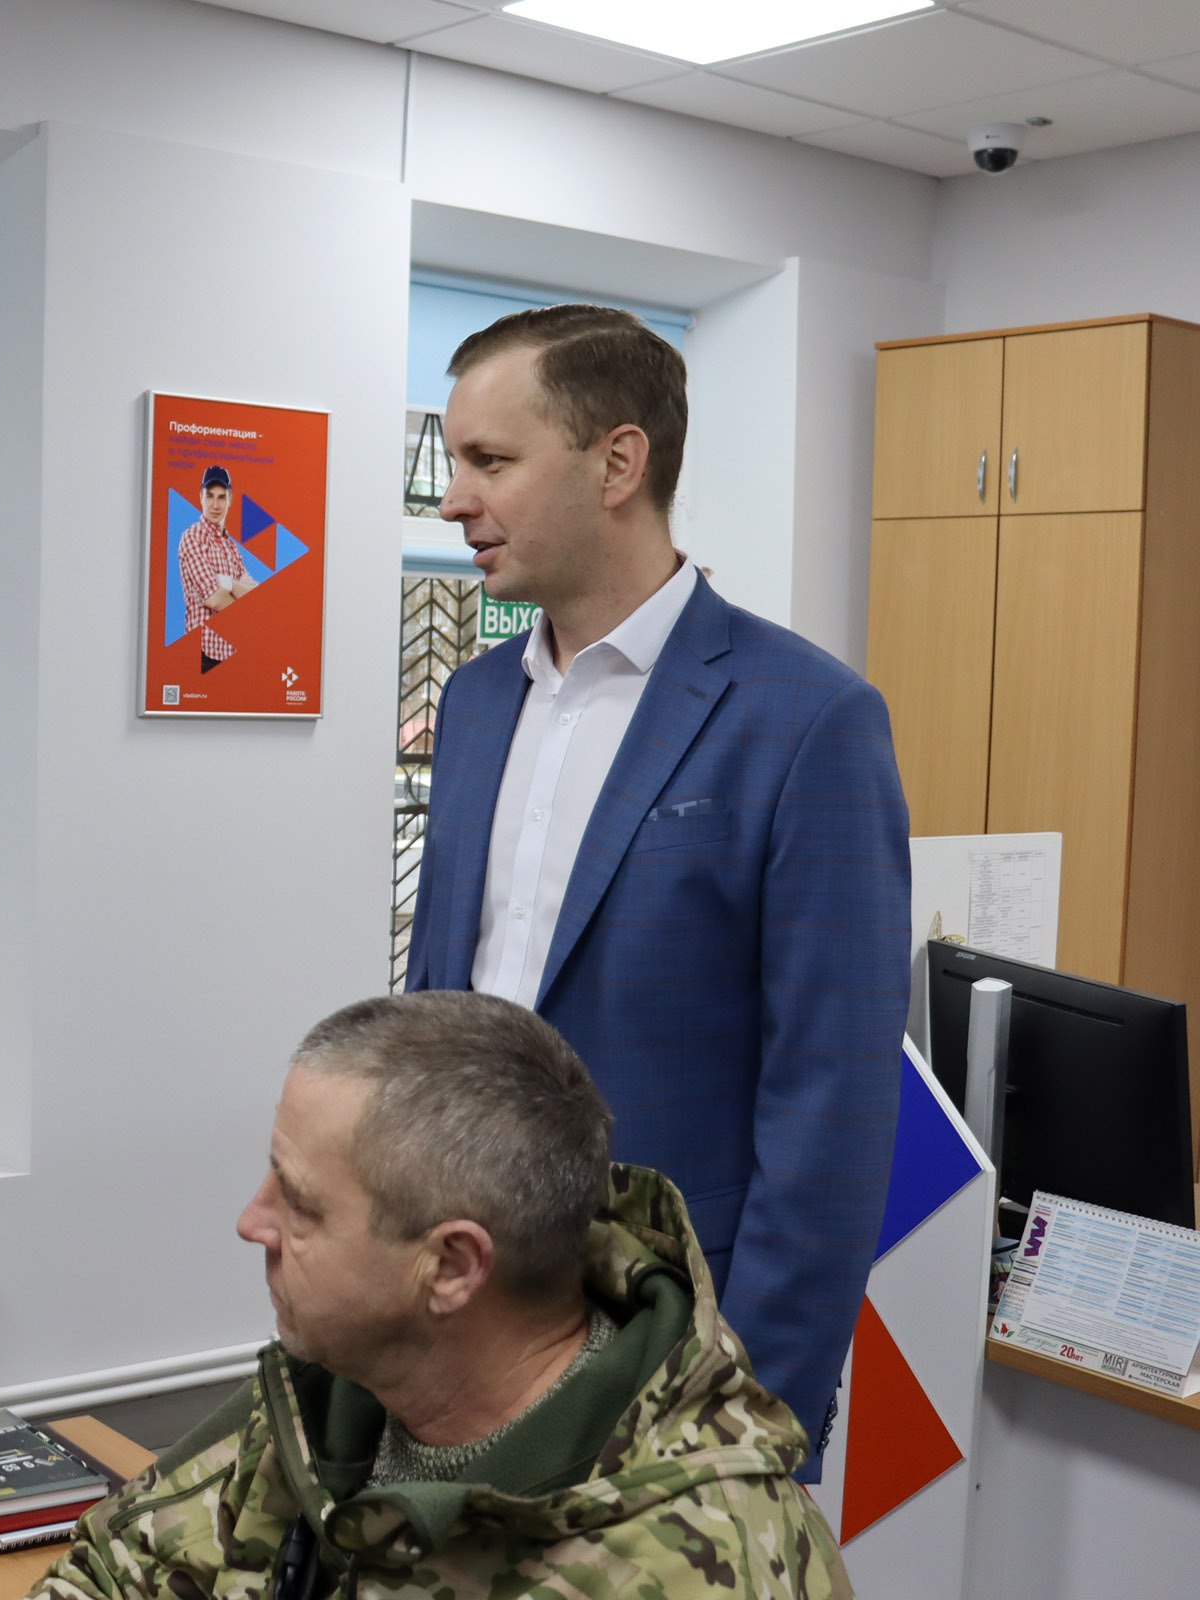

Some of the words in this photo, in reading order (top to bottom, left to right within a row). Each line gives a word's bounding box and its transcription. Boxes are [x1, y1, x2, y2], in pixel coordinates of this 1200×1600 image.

[169, 421, 257, 439] Профориентация
[1103, 1353, 1124, 1368] MIR
[1131, 1362, 1182, 1381] АРХИТЕКТУРНАЯ
[1140, 1372, 1180, 1388] МАСТЕРСКАЯ
